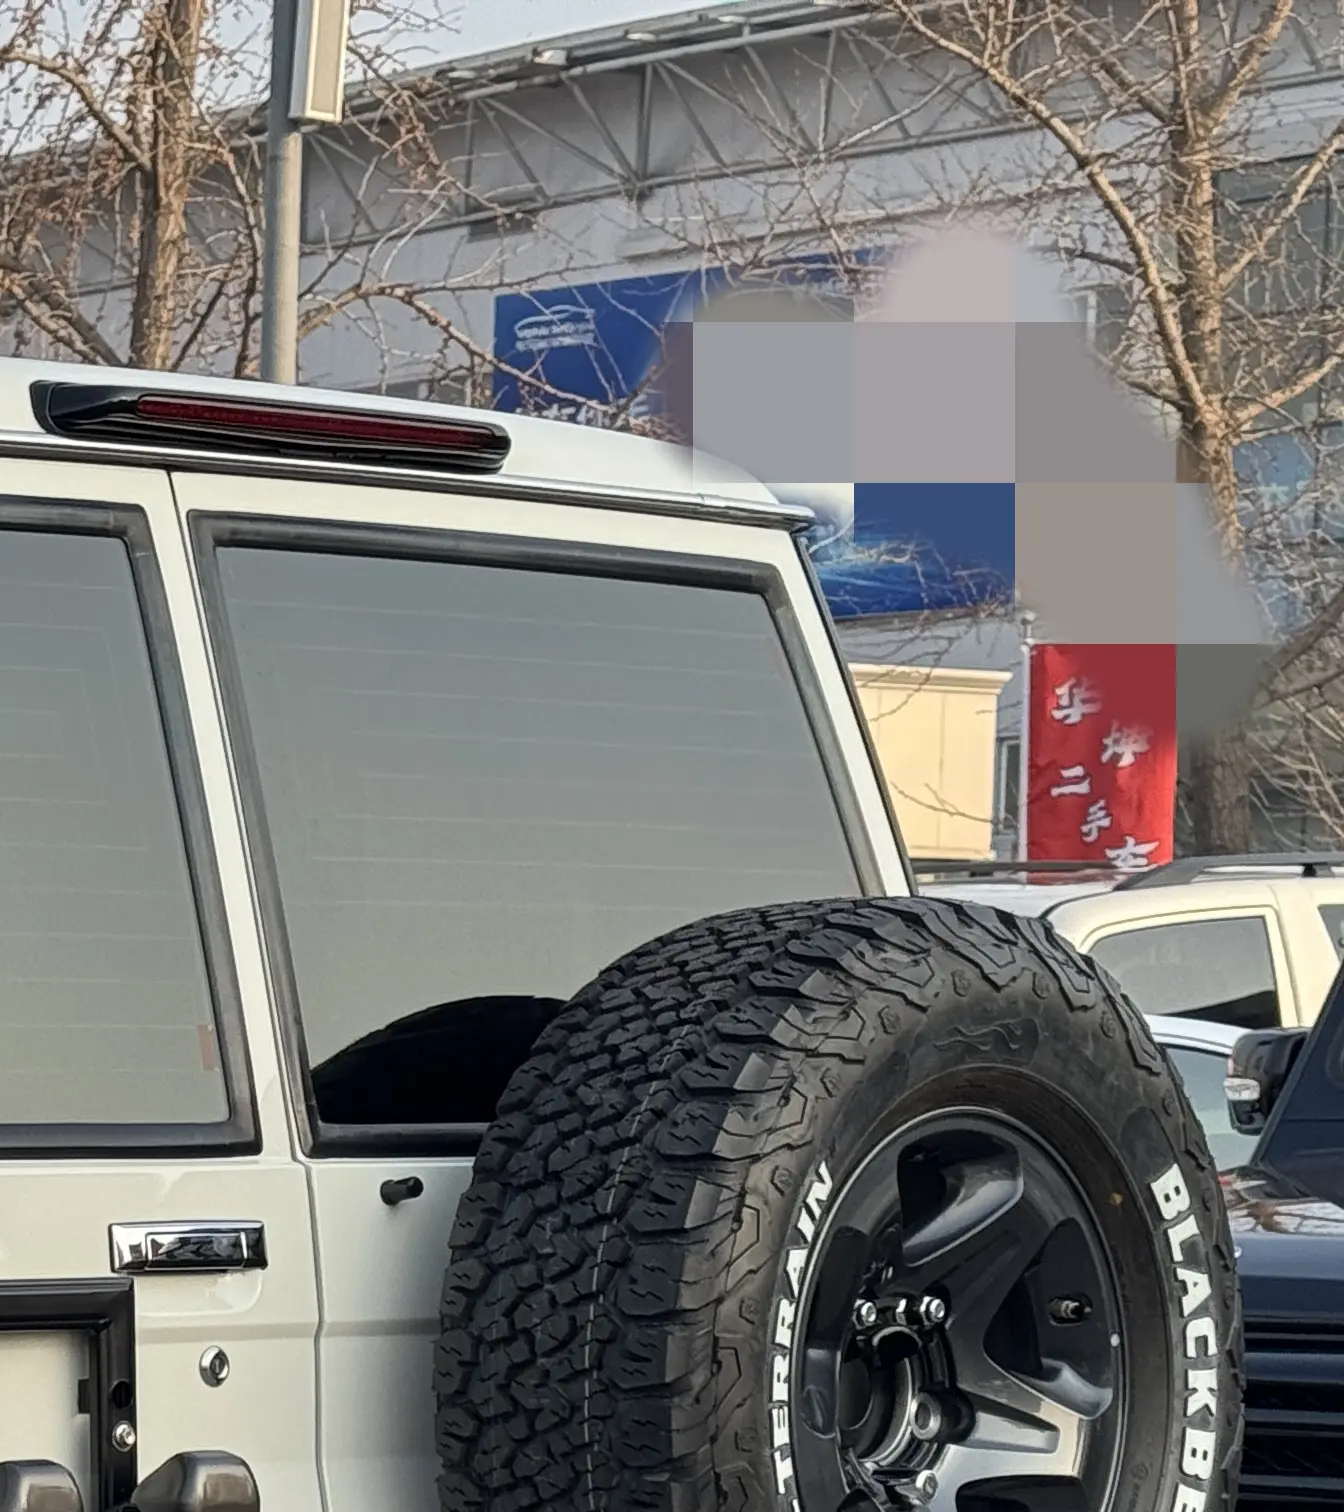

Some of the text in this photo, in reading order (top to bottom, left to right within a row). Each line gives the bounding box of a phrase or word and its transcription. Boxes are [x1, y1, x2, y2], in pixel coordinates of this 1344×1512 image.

[1050, 764, 1161, 874] 二手车
[768, 1159, 834, 1496] TERRAIN
